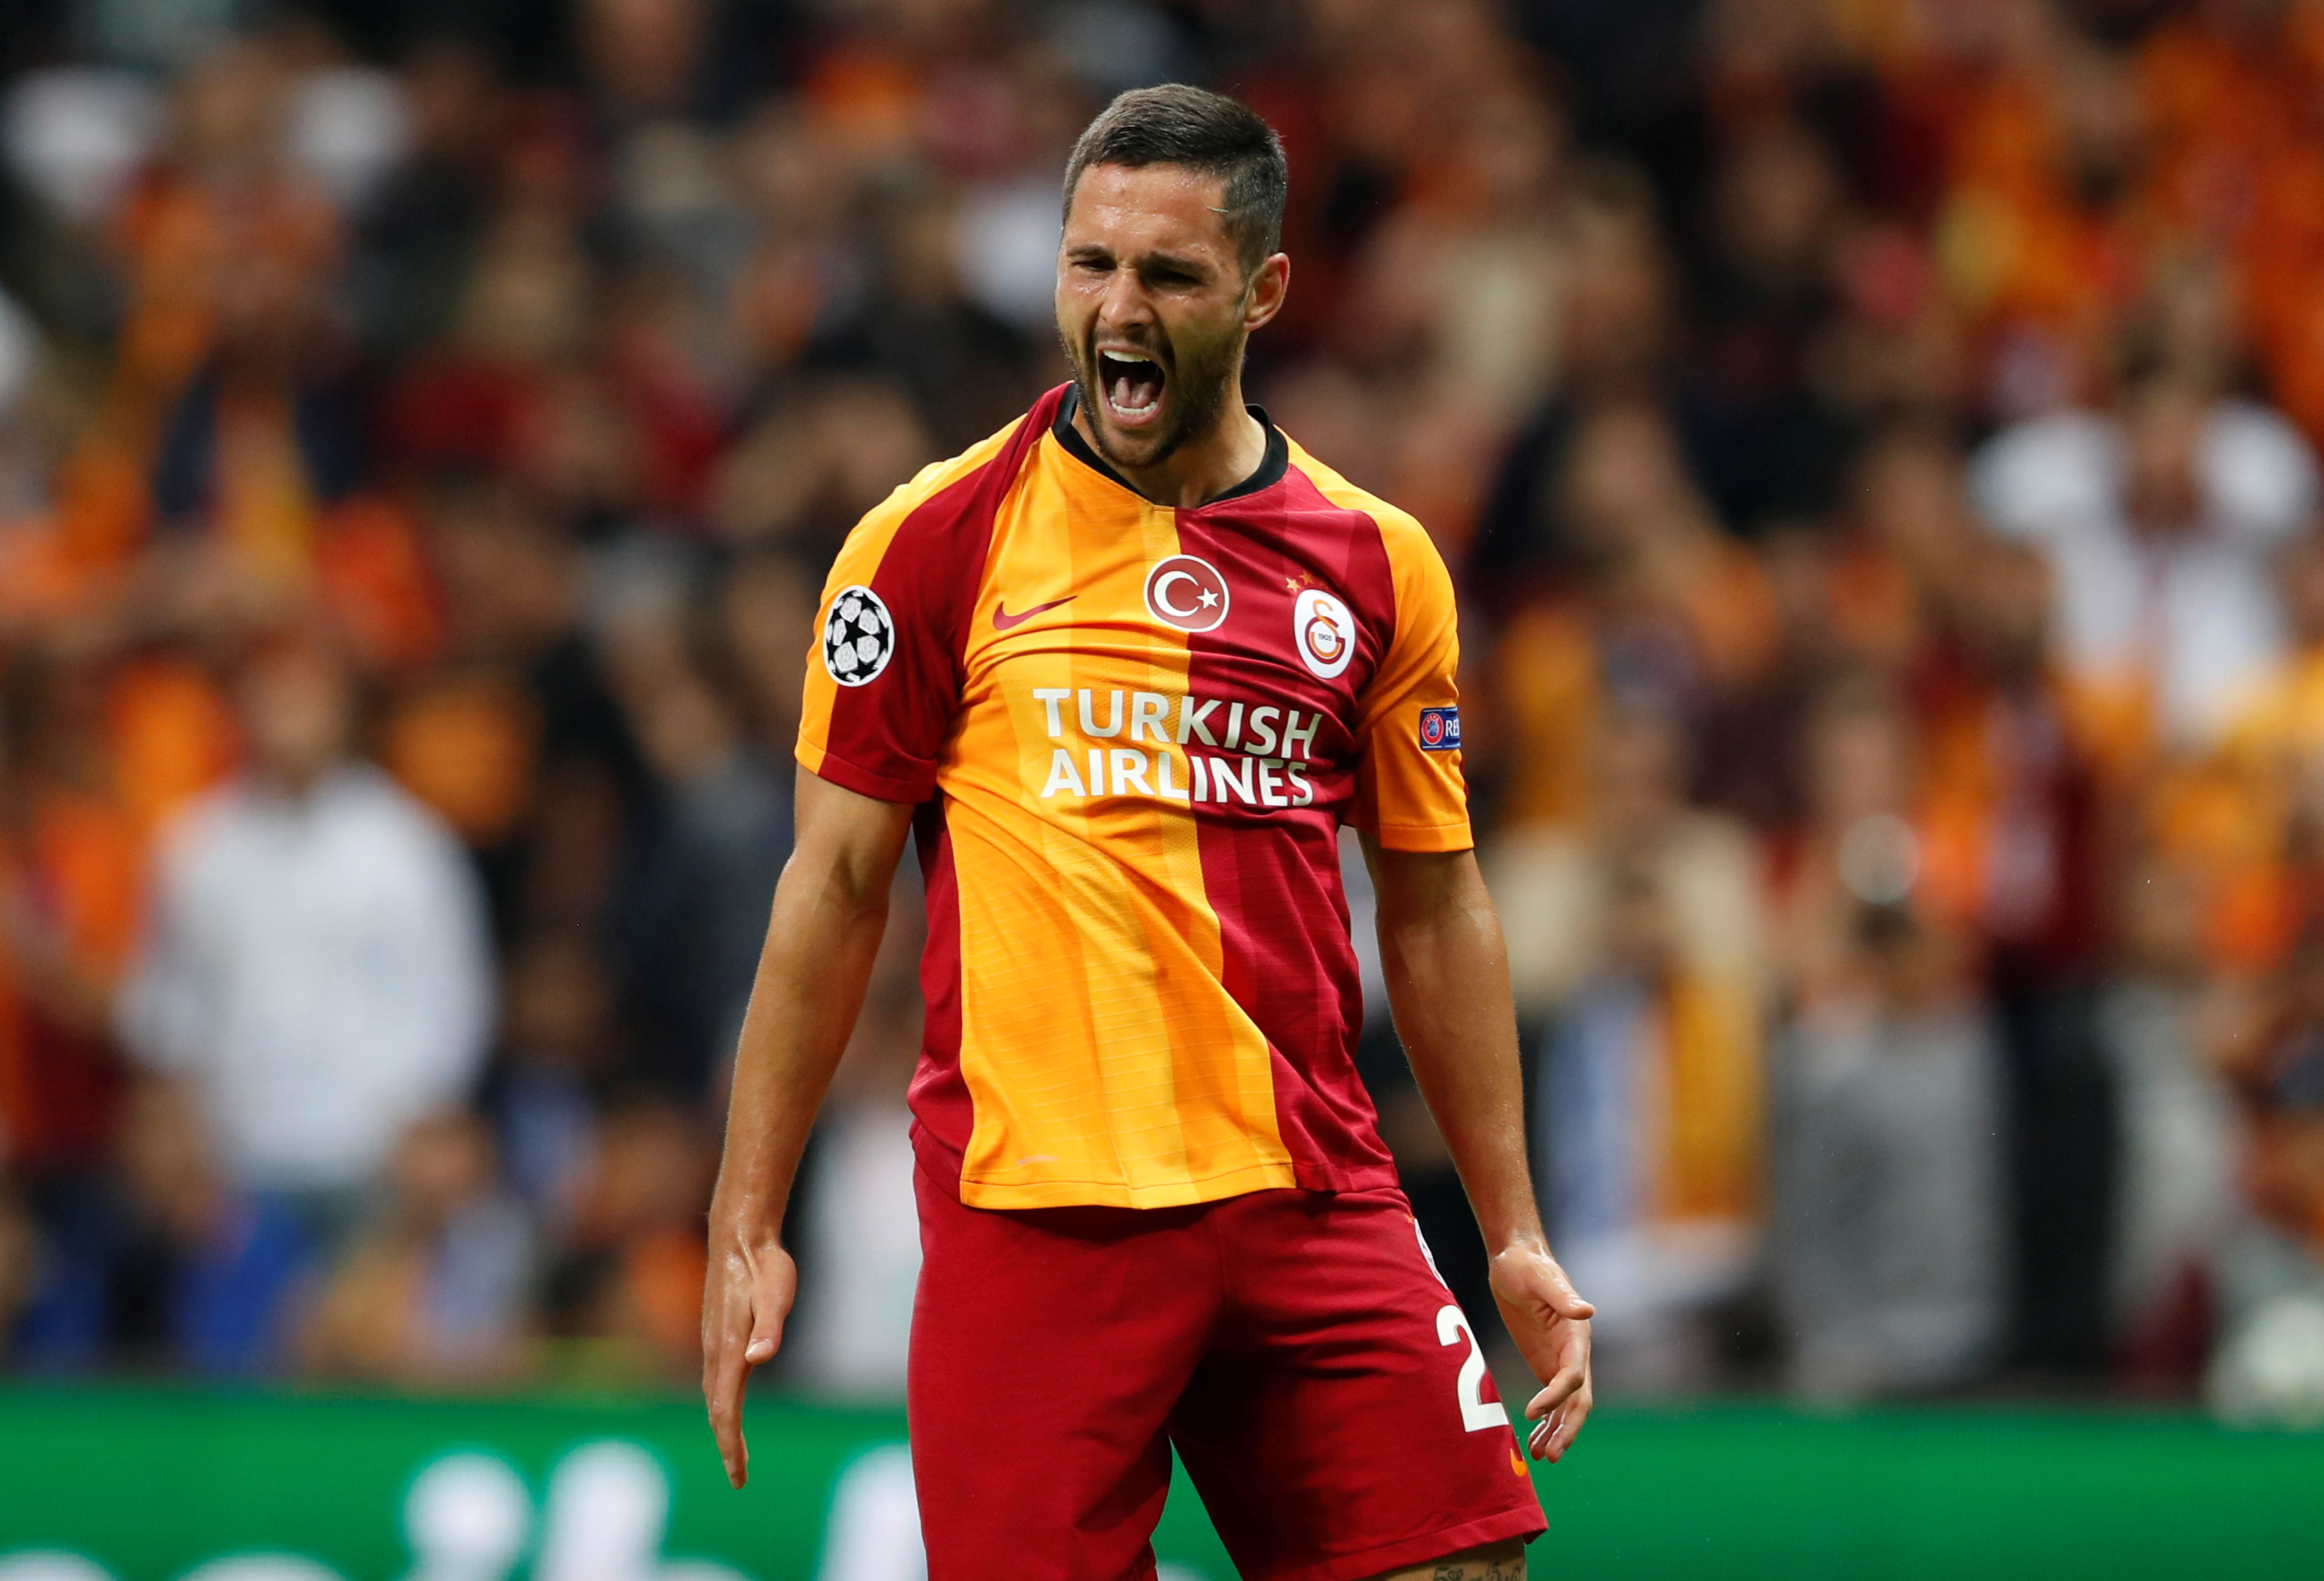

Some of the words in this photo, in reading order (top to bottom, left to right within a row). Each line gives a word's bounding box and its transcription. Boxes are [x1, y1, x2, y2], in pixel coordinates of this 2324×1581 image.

[1318, 633, 1332, 642] 1905
[1033, 688, 1323, 759] TURKISH
[1040, 748, 1314, 807] AIRLINES
[1436, 1305, 1509, 1433] 2
